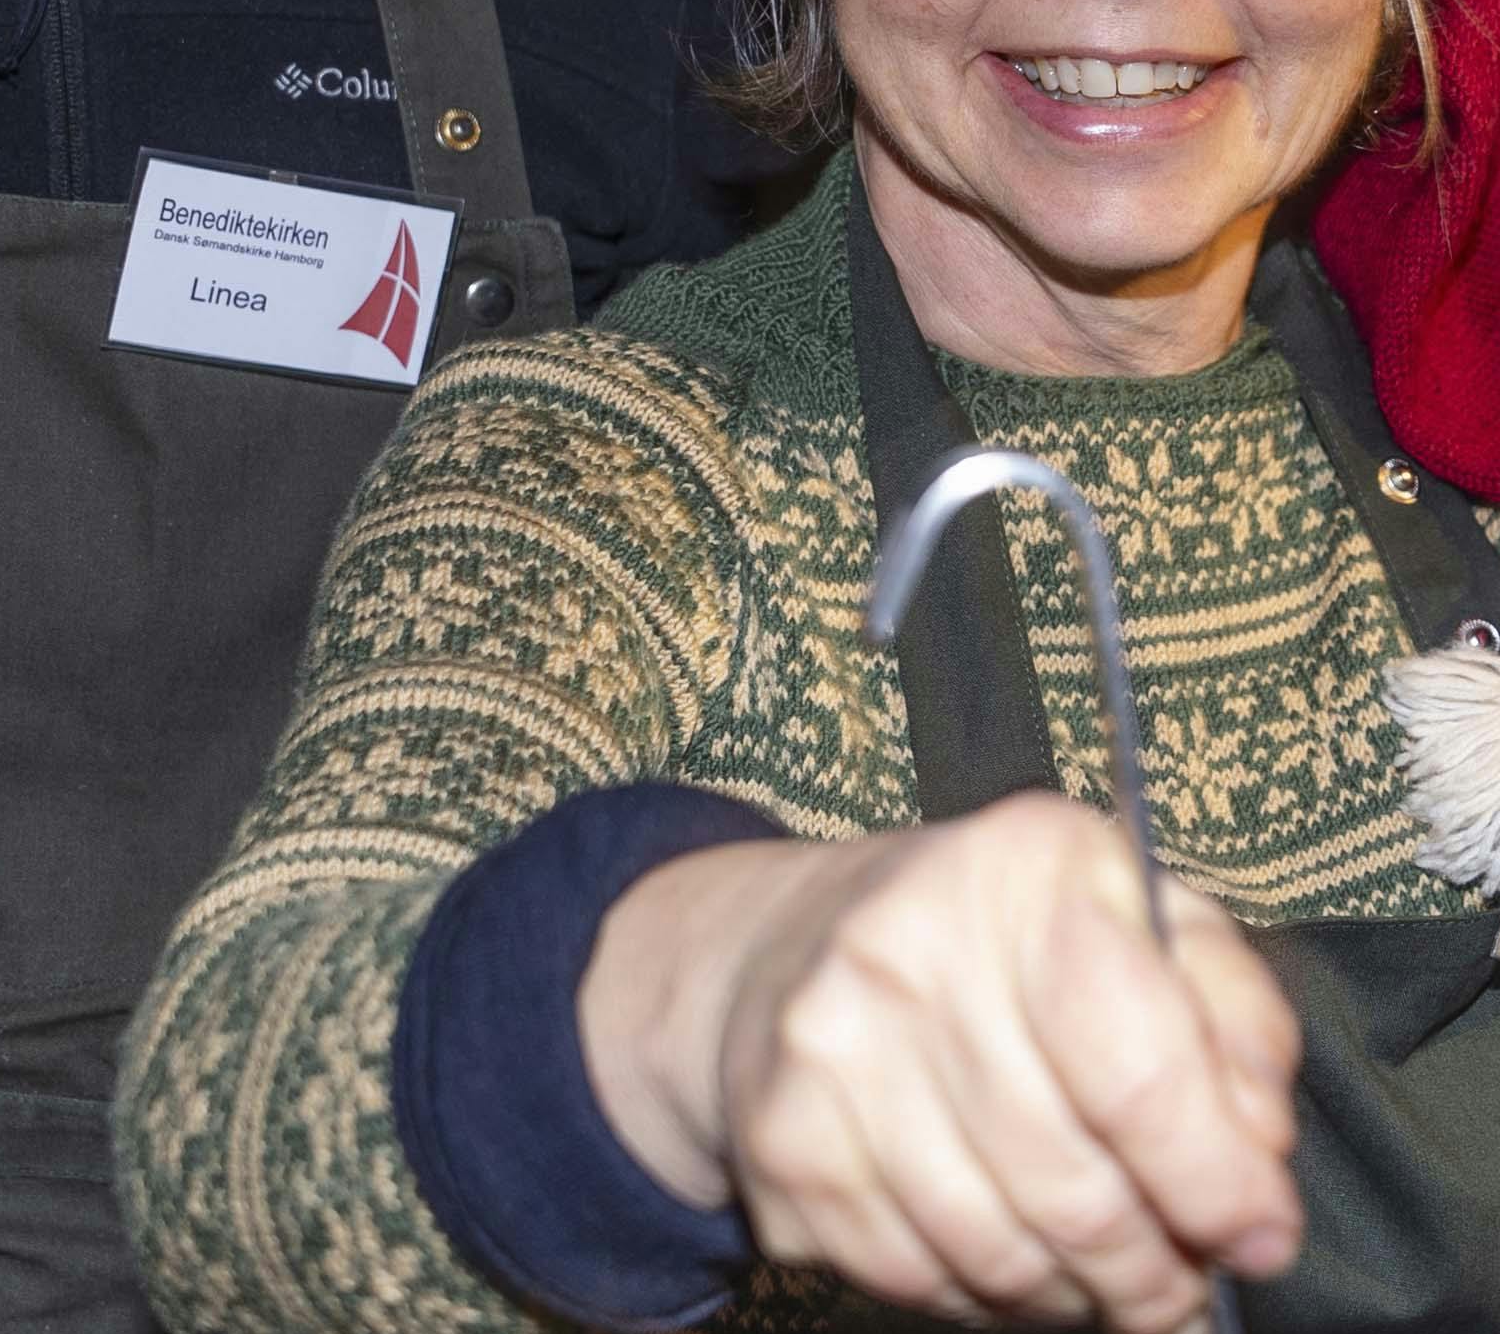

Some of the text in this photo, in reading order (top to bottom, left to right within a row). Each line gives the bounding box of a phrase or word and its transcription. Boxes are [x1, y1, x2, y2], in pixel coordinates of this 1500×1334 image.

[159, 198, 329, 249] Benediktekirken
[154, 229, 324, 269] Dansk Sømandskirke Hamborg
[189, 277, 268, 312] Linea
